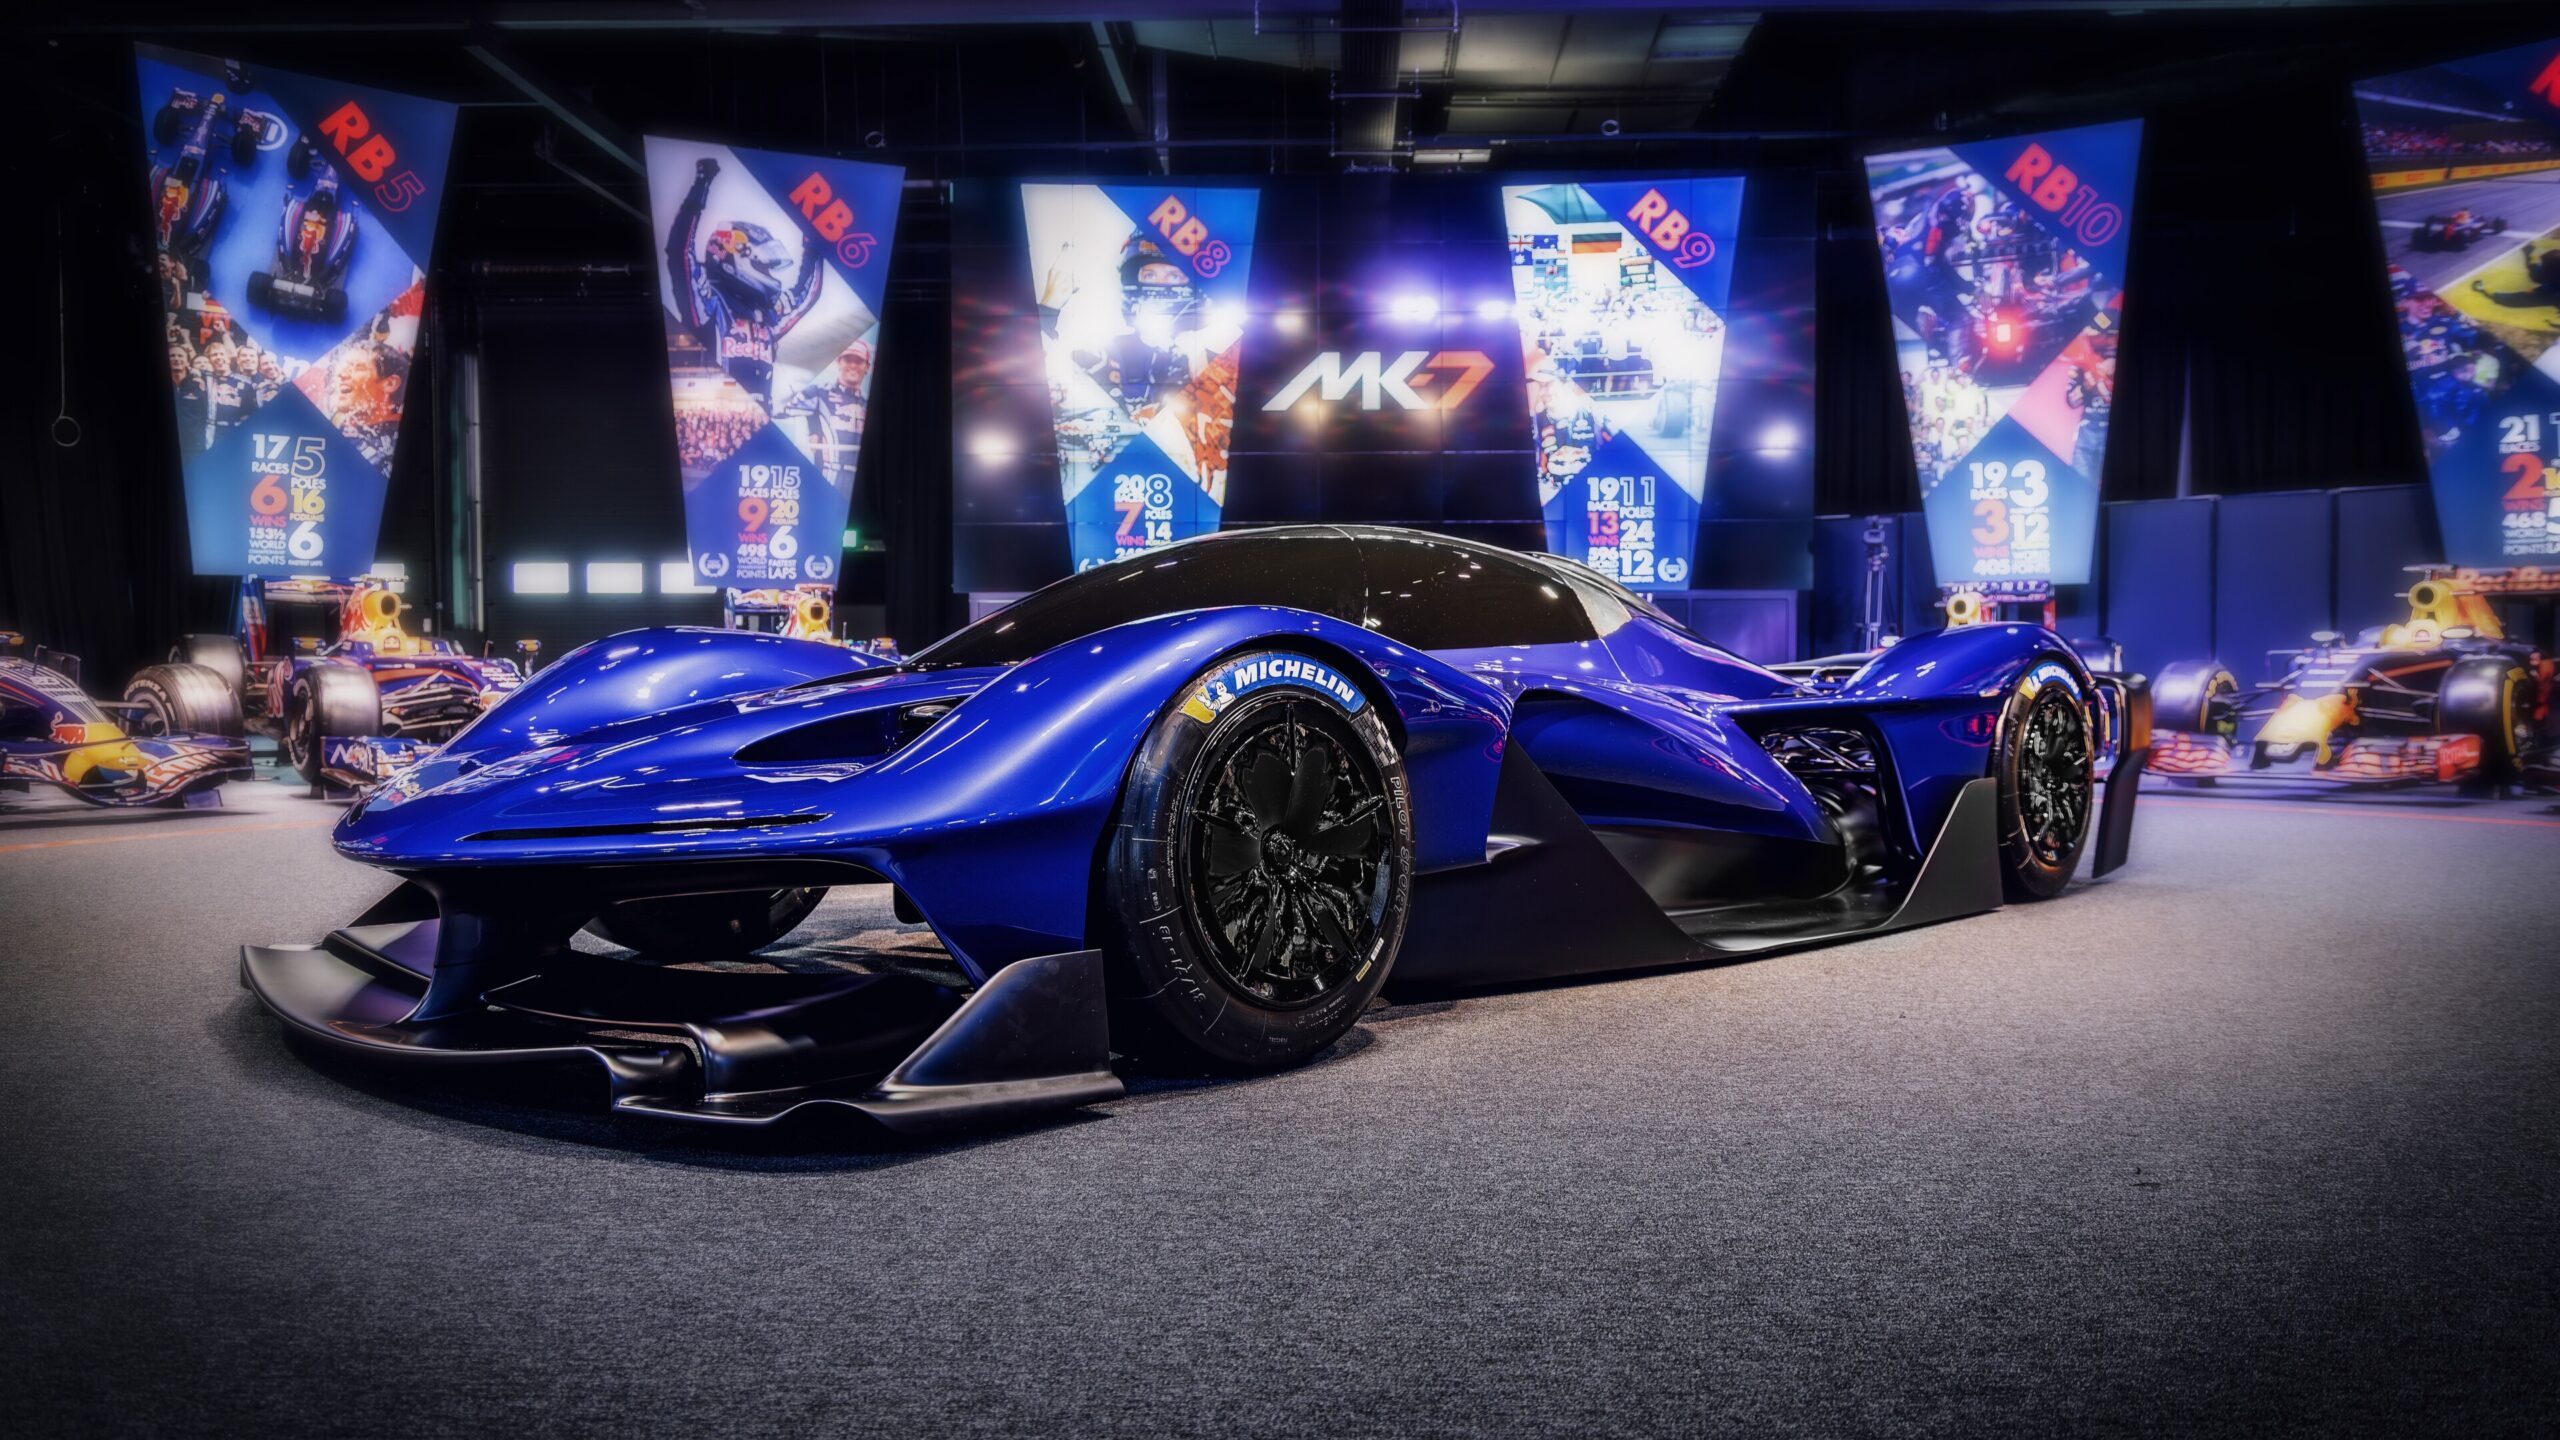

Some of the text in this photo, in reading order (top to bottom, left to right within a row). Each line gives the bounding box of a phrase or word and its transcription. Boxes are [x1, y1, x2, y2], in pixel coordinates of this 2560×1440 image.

[318, 101, 426, 212] RB5
[2004, 142, 2122, 247] RB10
[789, 171, 877, 268] RB6
[1627, 188, 1716, 268] RB9
[1148, 194, 1231, 278] RB8
[2499, 414, 2540, 443] 21
[252, 434, 290, 459] 17
[291, 436, 326, 478] 5
[251, 462, 289, 474] RACES
[739, 465, 770, 487] 19
[770, 465, 801, 488] 15
[1969, 461, 2007, 488] 19
[2501, 452, 2545, 500] 2
[251, 475, 288, 515] 6
[291, 478, 326, 489] POLES
[739, 488, 770, 498] RACES
[770, 488, 800, 499] POLES
[1145, 473, 1174, 510] 8
[1587, 476, 1620, 500] 19
[1620, 476, 1655, 506] 11
[2009, 459, 2049, 508] 3
[291, 489, 325, 515] 16
[738, 497, 768, 532] 9
[770, 500, 799, 518] 20
[1620, 506, 1655, 519] POLES
[250, 515, 287, 527] WINS
[1114, 502, 1145, 536] 7
[1145, 521, 1172, 540] 14
[1587, 511, 1619, 535] 13
[1620, 519, 1655, 542] 24
[1971, 498, 2010, 545] 3
[2010, 513, 2050, 548] 12
[249, 540, 286, 550] WORLD
[288, 521, 324, 560] 6
[737, 544, 767, 557] 498
[738, 532, 768, 544] WINS
[769, 525, 798, 559] 6
[1115, 535, 1145, 546] WINS
[248, 554, 286, 566] POINTS
[737, 557, 767, 565] WORLD
[768, 567, 797, 579] LAPS
[1620, 549, 1655, 575] 12
[737, 569, 767, 579] POINTS
[1234, 659, 1355, 703] MICHELIN
[1390, 776, 1410, 841] PILOT
